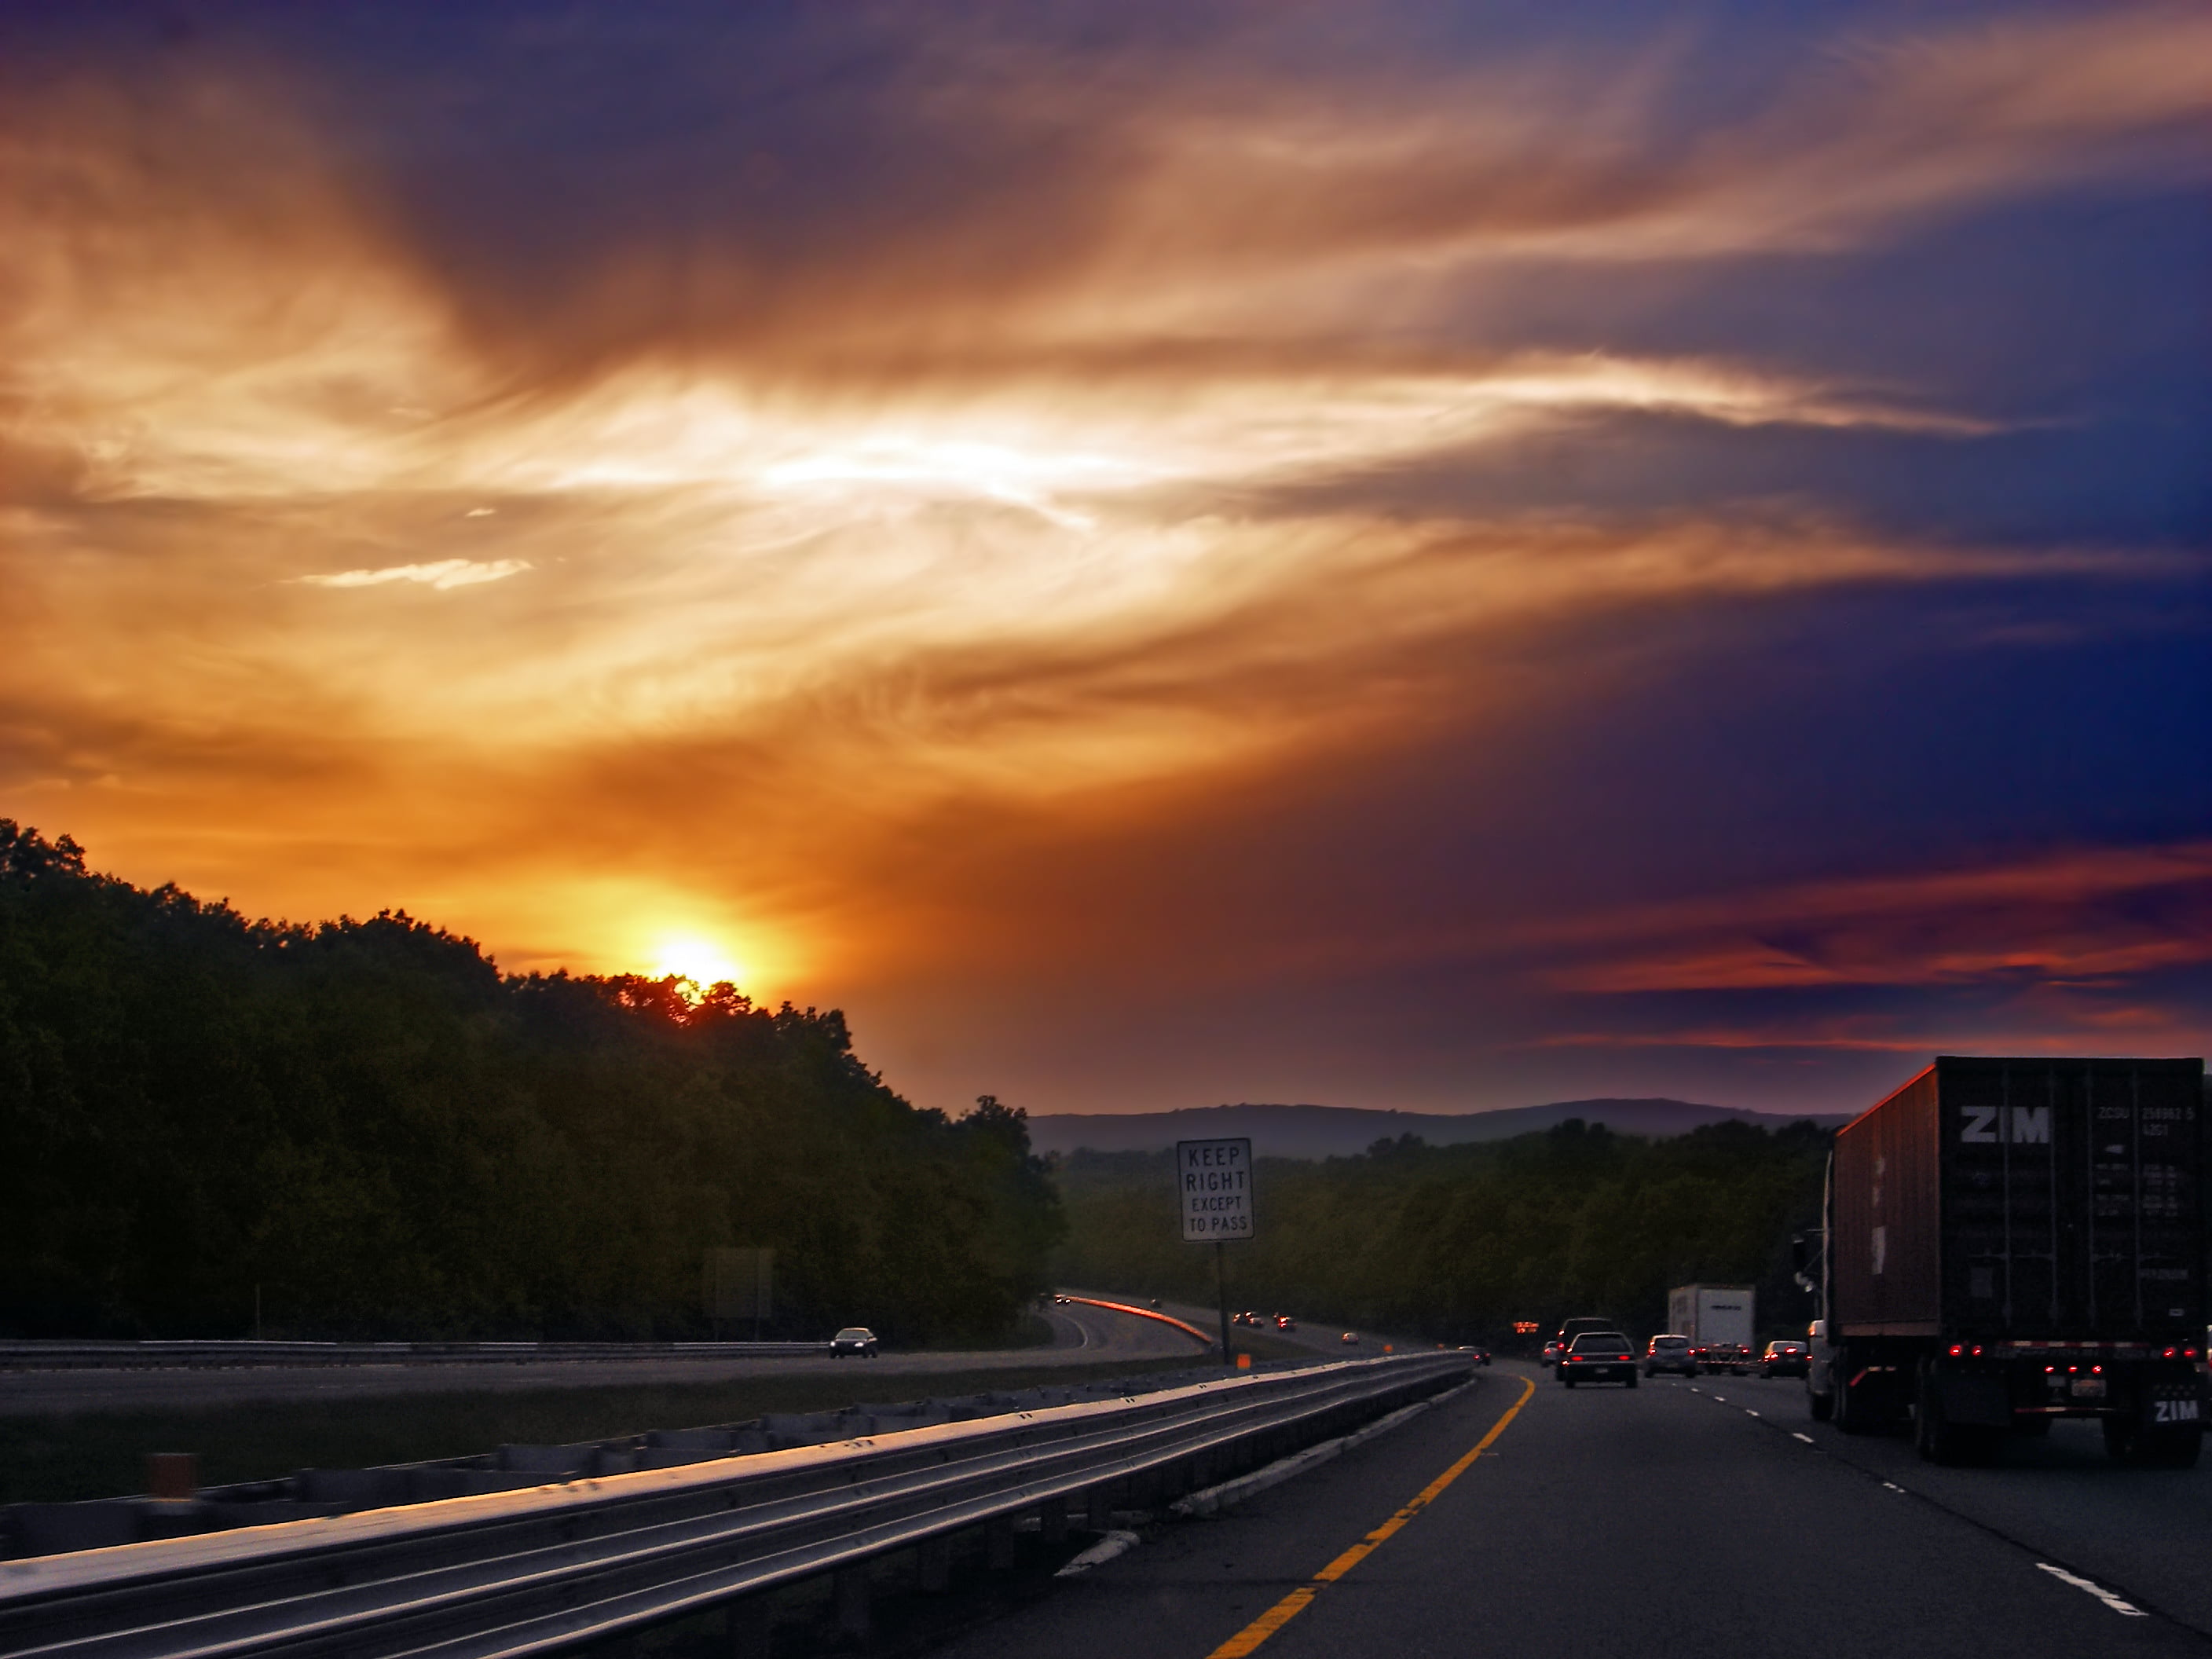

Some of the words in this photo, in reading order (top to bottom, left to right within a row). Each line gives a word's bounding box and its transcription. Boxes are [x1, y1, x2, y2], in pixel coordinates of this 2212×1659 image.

[1961, 1106, 2049, 1143] ZIM
[1188, 1147, 1240, 1166] KEEP
[1186, 1171, 1244, 1192] RIGHT
[1192, 1196, 1241, 1212] EXCEPT
[1191, 1218, 1206, 1232] TO
[1212, 1216, 1247, 1231] PASS
[2154, 1400, 2199, 1423] ZIM
